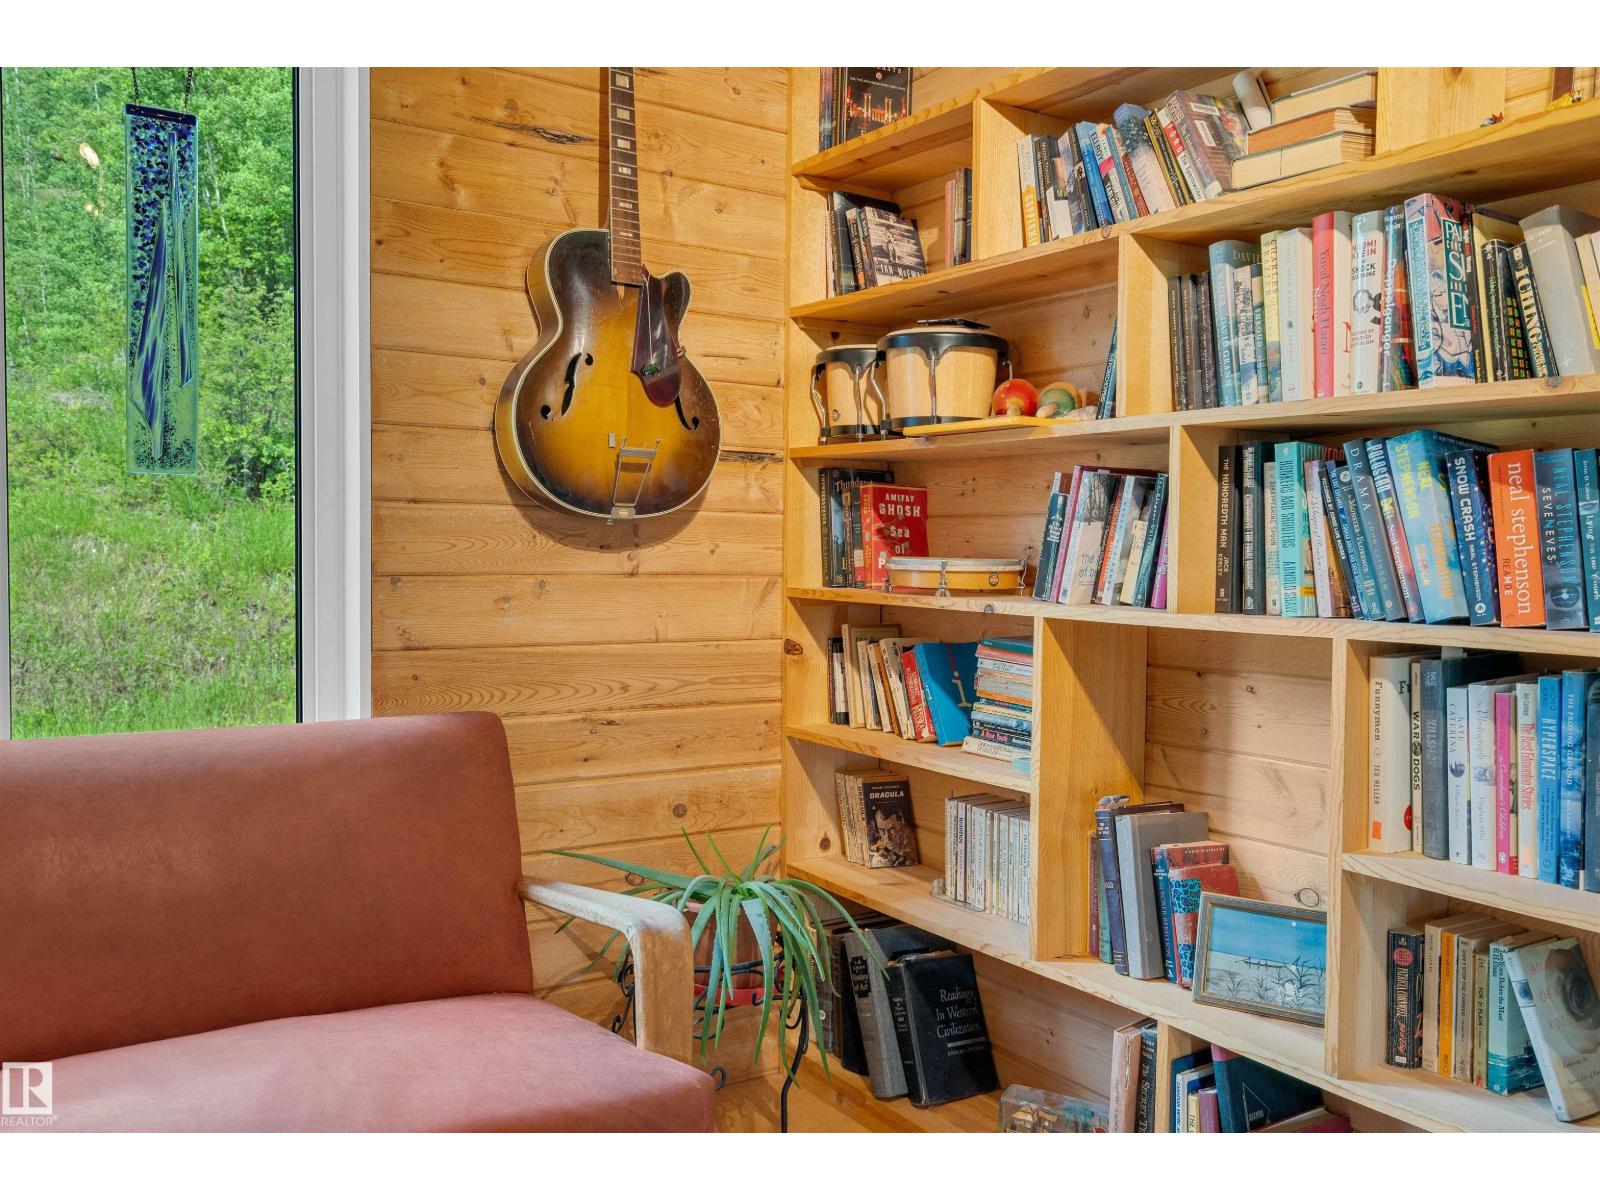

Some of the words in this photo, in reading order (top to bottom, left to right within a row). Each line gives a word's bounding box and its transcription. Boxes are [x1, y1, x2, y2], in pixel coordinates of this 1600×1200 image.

[1090, 132, 1103, 160] ELLROY
[1165, 123, 1184, 153] FORD
[1267, 239, 1281, 293] CHARLES
[1319, 248, 1330, 279] Yuval
[1318, 283, 1330, 313] Noah
[1219, 316, 1228, 347] DAVID
[1254, 308, 1262, 347] SHROUD
[1318, 319, 1330, 355] Harari
[1221, 350, 1231, 386] GRANN
[1279, 461, 1293, 492] HONKERS
[1349, 447, 1371, 511] DRAMA
[1395, 443, 1420, 519] STEPHENSON
[1453, 457, 1469, 494] SNOW
[1507, 462, 1529, 501] neal
[1552, 467, 1570, 496] NEAL
[878, 503, 921, 518] GHOSH
[1221, 474, 1230, 525] HUNDREDTH
[1280, 495, 1294, 509] AND
[890, 526, 910, 538] Sea
[1280, 513, 1295, 548] SHOUTERS
[1459, 498, 1476, 541] CRASH
[1542, 487, 1556, 565] SEVENEVES
[1584, 514, 1595, 540] Lying
[1221, 528, 1229, 549] MAN
[1555, 503, 1577, 583] STEPHENSON
[1356, 536, 1369, 573] FLORENCE
[1505, 507, 1537, 615] stephenson
[1282, 561, 1296, 589] ARNOLD
[1391, 545, 1410, 598] Stephenson
[1470, 562, 1482, 601] STEPHENSON
[1502, 558, 1513, 596] REAMDE
[1283, 592, 1296, 612] SHAW
[1374, 681, 1383, 741] Funnymen
[1447, 703, 1457, 752] CATERINA
[1522, 723, 1534, 735] The
[1520, 736, 1534, 751] Best
[1542, 718, 1556, 781] HYPERSPACE
[870, 791, 904, 799] DRACULA
[1519, 786, 1534, 809] Stories
[939, 986, 974, 1003] Readings
[1497, 976, 1505, 995] Before
[936, 1009, 945, 1021] In
[946, 1005, 977, 1019] Western
[937, 1022, 981, 1038] Civilization
[1139, 1080, 1149, 1117] SECRET
[1188, 1114, 1196, 1128] THE
